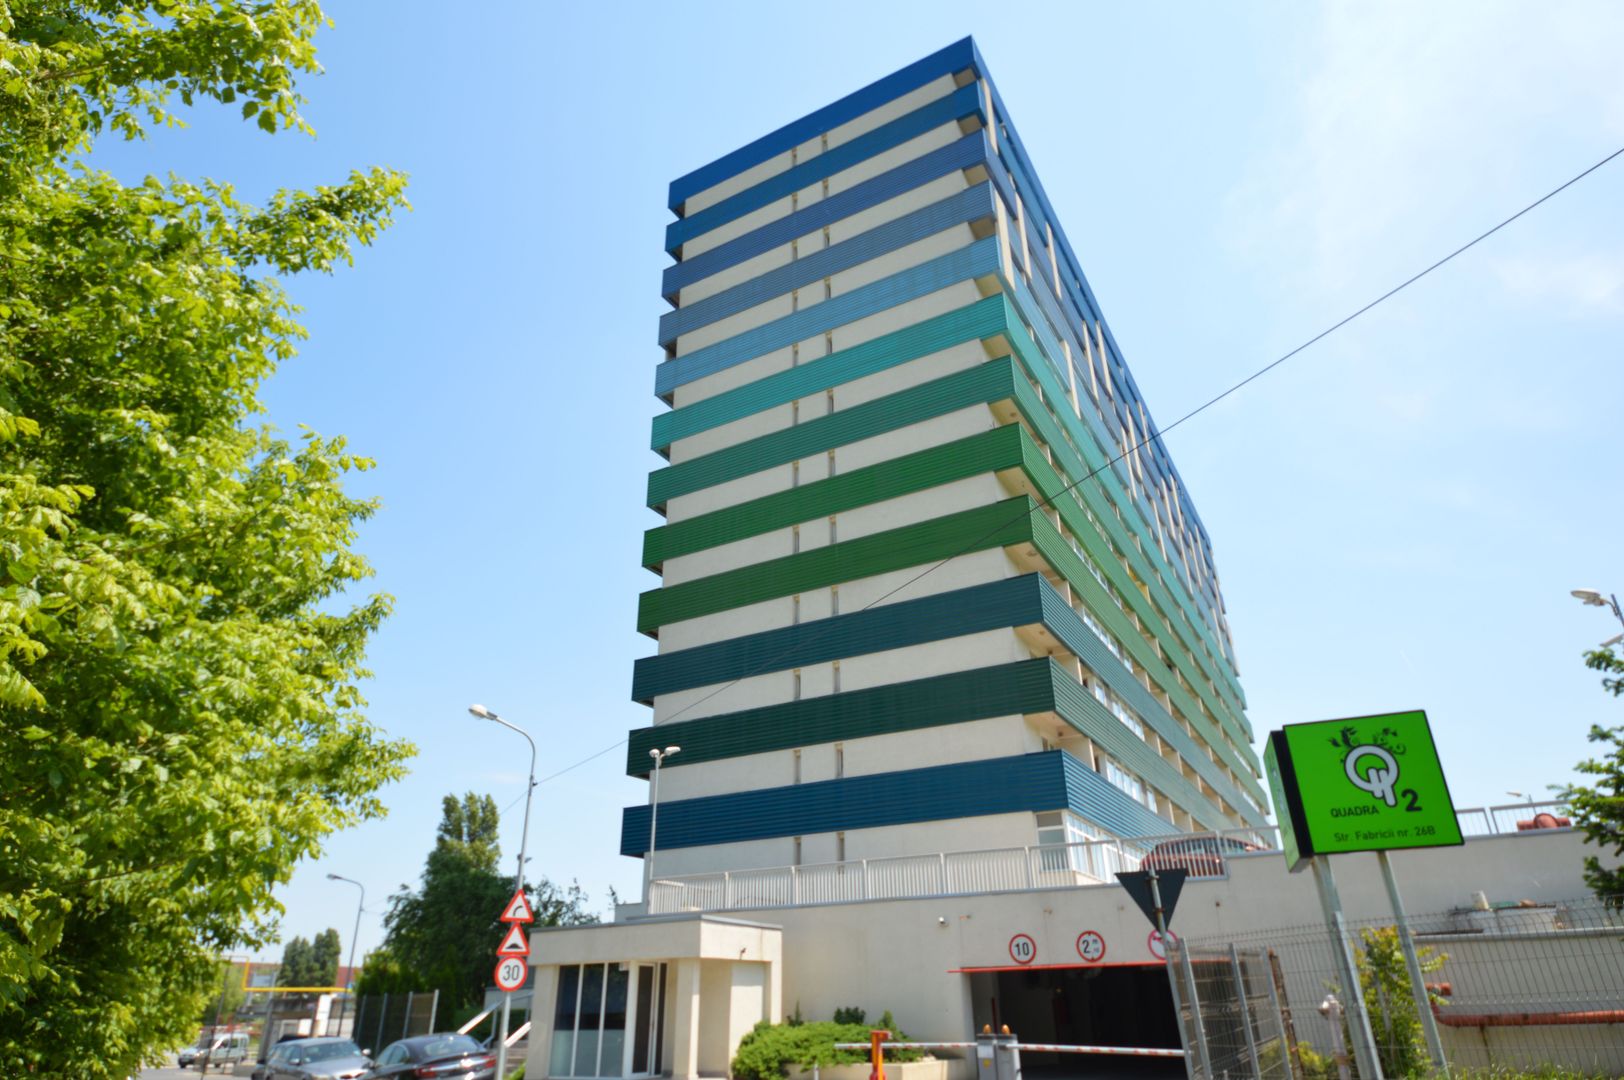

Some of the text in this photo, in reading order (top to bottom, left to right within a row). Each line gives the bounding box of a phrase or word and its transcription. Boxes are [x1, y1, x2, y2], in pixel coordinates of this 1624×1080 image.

[1401, 788, 1422, 812] 2
[1331, 805, 1379, 818] QUADRA
[1355, 829, 1395, 840] Fabricii
[1414, 825, 1436, 836] 26B
[1014, 942, 1030, 956] 10
[503, 965, 520, 981] 30
